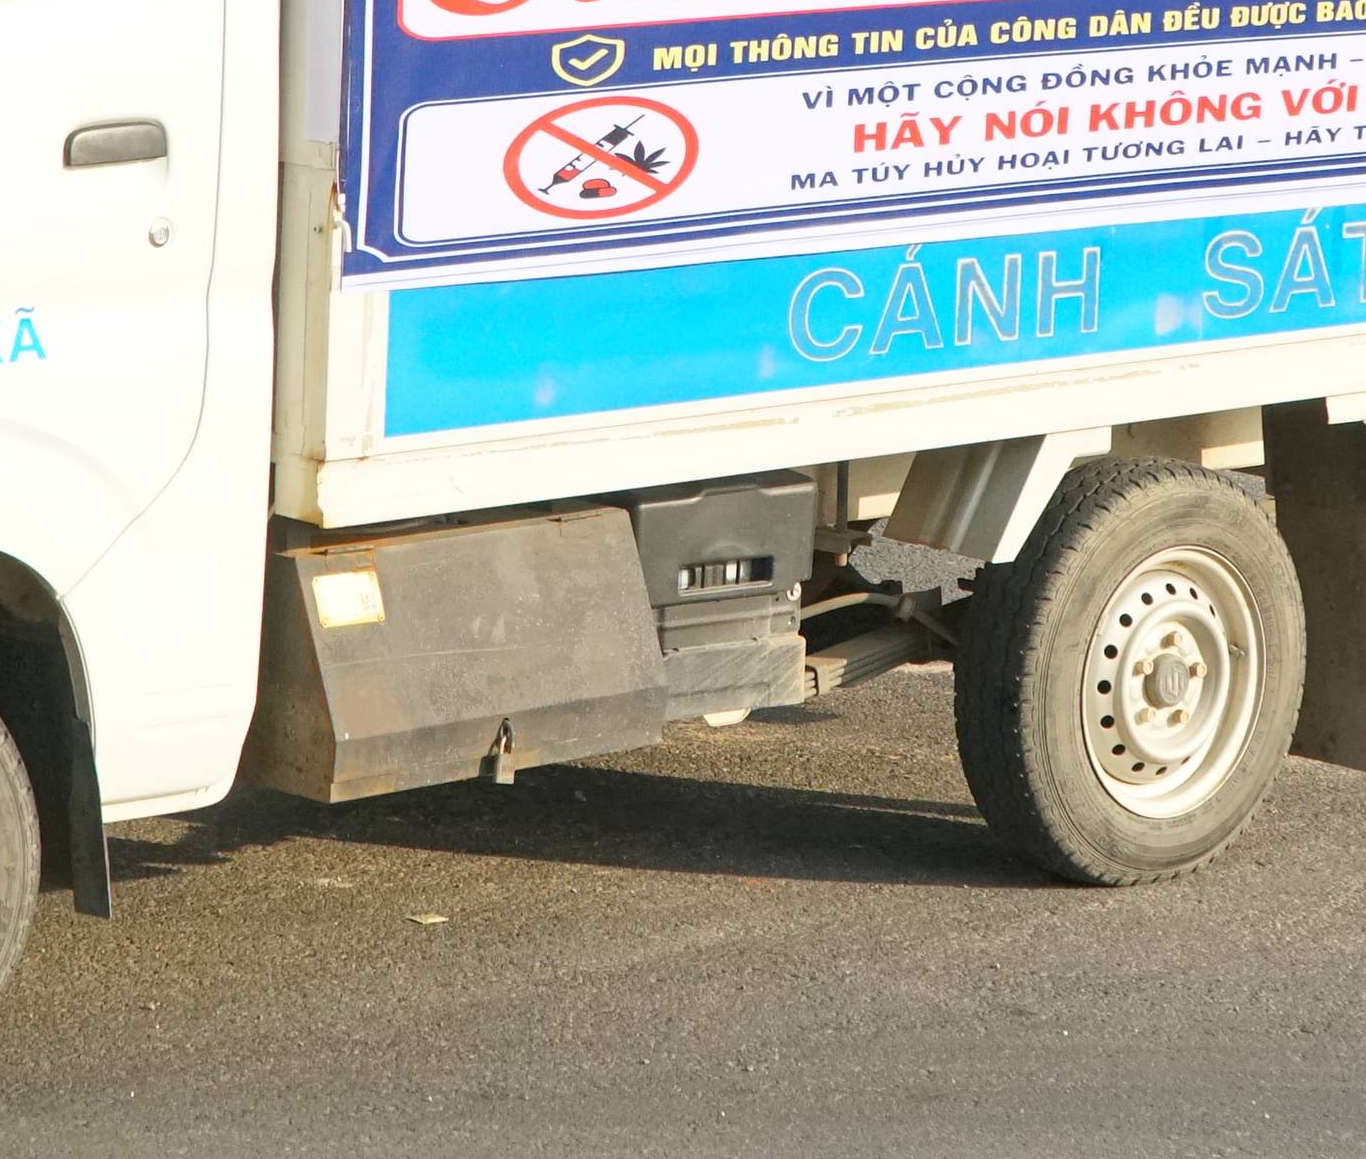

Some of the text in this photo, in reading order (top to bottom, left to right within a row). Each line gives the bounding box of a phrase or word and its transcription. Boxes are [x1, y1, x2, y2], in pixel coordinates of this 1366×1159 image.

[654, 44, 716, 71] MỌI
[731, 34, 838, 63] THÔNG
[852, 30, 903, 54] TIN
[916, 19, 977, 49] CỦA
[991, 17, 1076, 43] CÔNG
[1090, 10, 1151, 36] DÂN
[1163, 2, 1219, 31] ĐỀU
[1231, 2, 1306, 28] ĐƯỢC
[803, 86, 832, 108] VÌ
[848, 81, 920, 105] MỘT
[934, 75, 1026, 103] CỘNG
[1042, 58, 1133, 90] ĐỒNG
[1148, 55, 1232, 82] KHỎE
[1247, 54, 1336, 74] MẠNH
[854, 108, 960, 153] HÃY
[986, 96, 1068, 141] NÓI
[1089, 91, 1261, 132] KHÔNG
[1282, 77, 1357, 116] VỚI
[792, 172, 837, 189] MA
[852, 158, 909, 183] TÚY
[925, 149, 984, 177] HỦY
[998, 150, 1069, 170] HOẠI
[1083, 135, 1184, 161] TƯƠNG
[1199, 136, 1242, 152] LAI
[1285, 128, 1341, 145] HÃY
